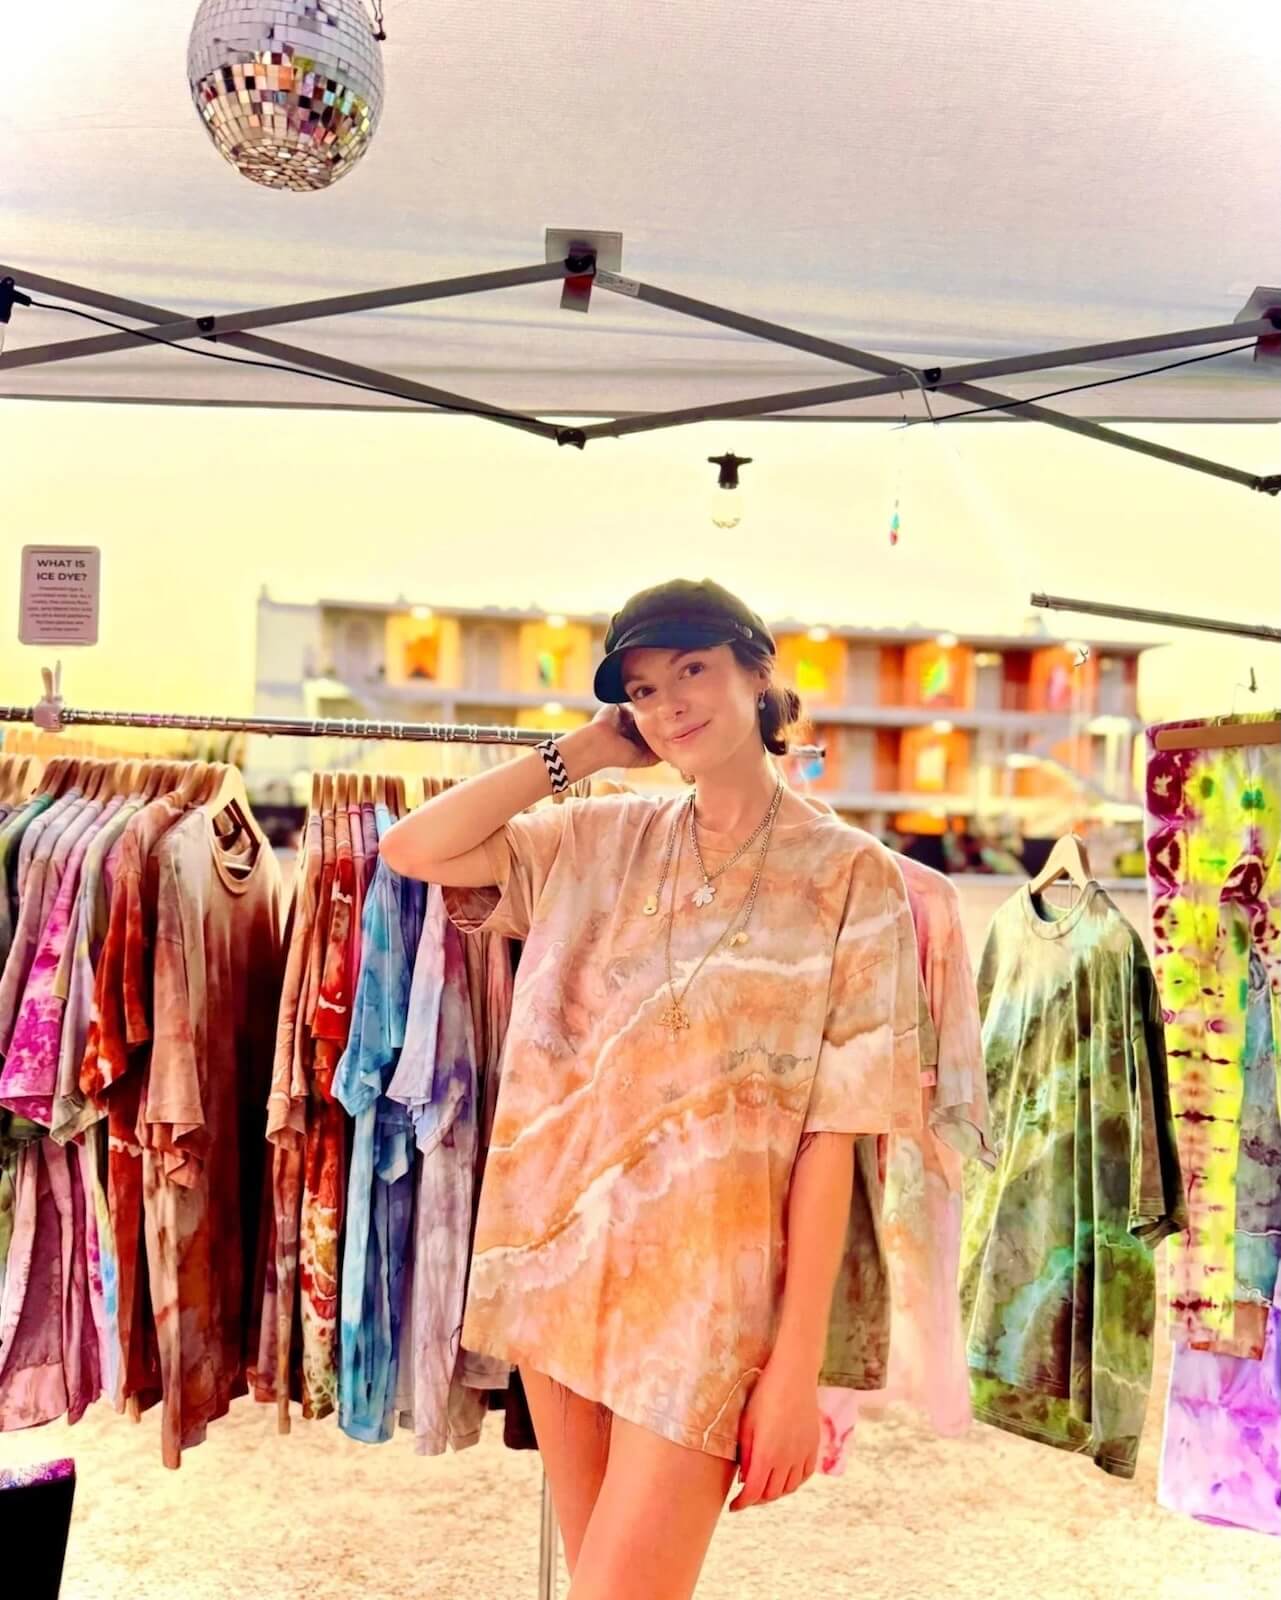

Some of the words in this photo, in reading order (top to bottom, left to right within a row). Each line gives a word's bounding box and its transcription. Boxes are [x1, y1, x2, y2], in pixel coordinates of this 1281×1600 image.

[75, 560, 86, 568] IS
[37, 572, 54, 580] ICE
[58, 572, 87, 581] DYE?
